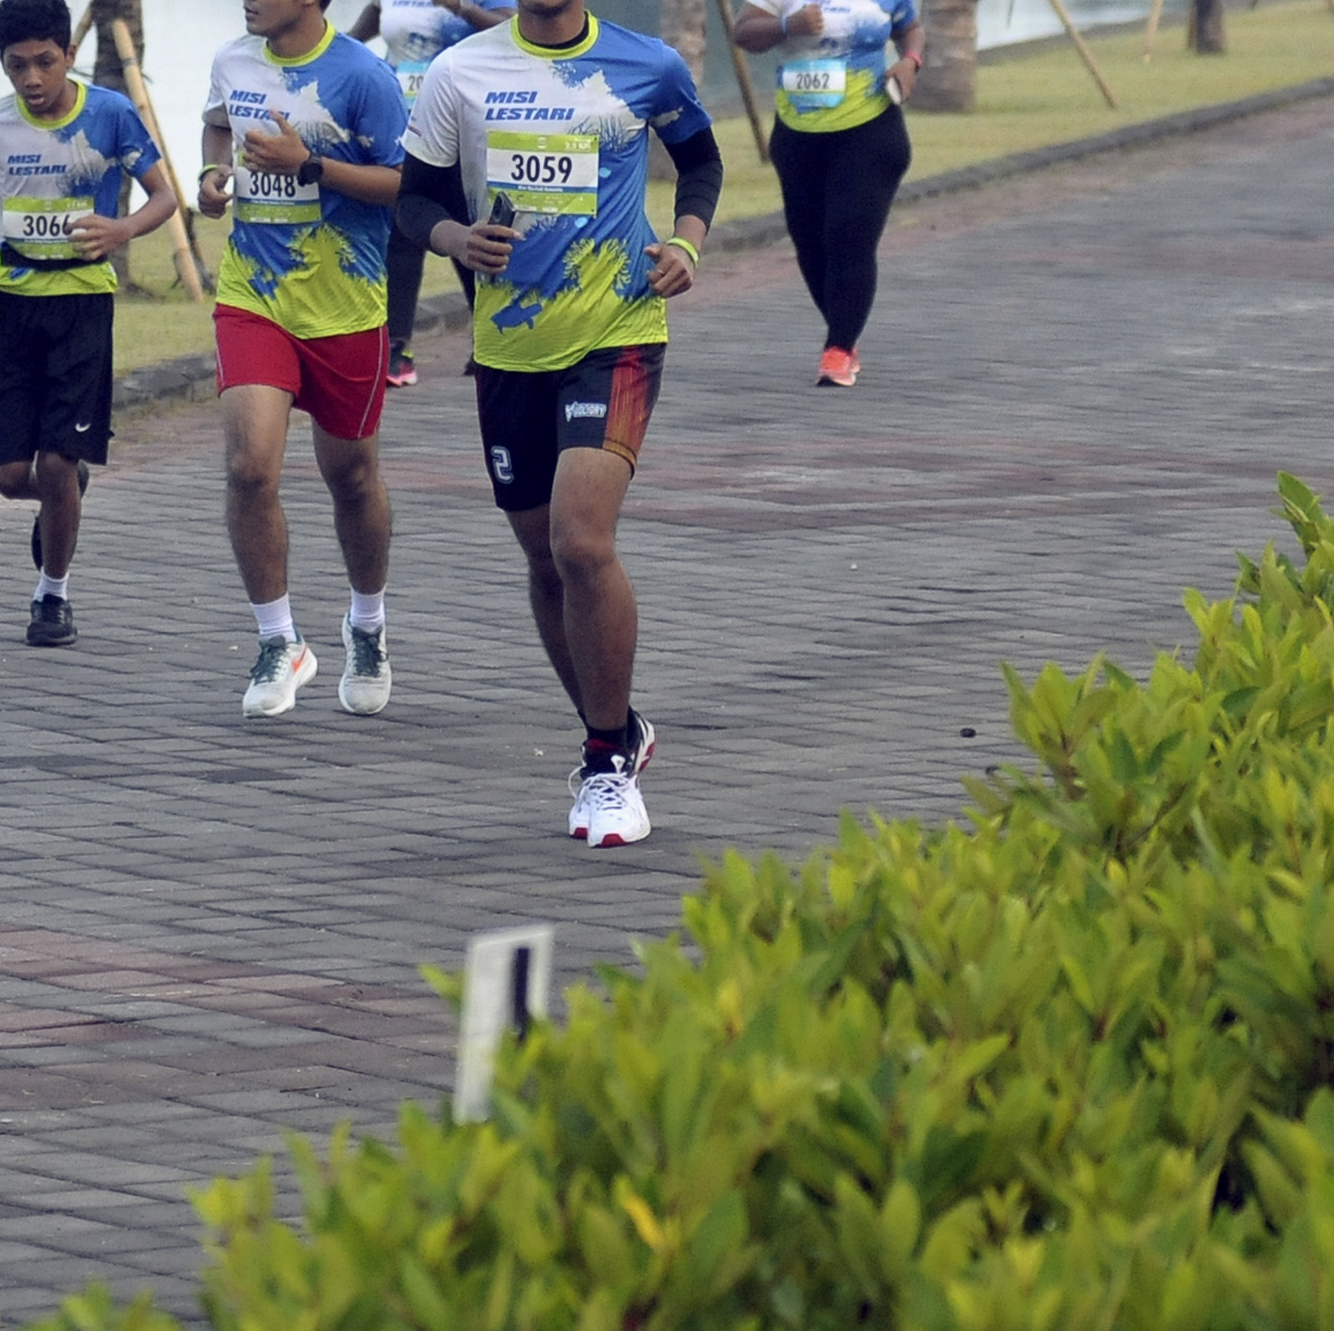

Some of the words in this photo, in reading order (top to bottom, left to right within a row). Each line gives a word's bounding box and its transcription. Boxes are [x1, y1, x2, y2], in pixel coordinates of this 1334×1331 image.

[796, 73, 830, 89] 2062
[229, 89, 267, 104] MISI
[485, 91, 538, 104] MISI
[229, 104, 291, 120] LESTAI
[485, 108, 575, 121] LESTARI
[7, 154, 42, 164] MISI
[8, 164, 67, 176] LESTARI
[511, 154, 573, 183] 3059
[249, 171, 296, 198] 3048
[491, 445, 514, 484] 2
